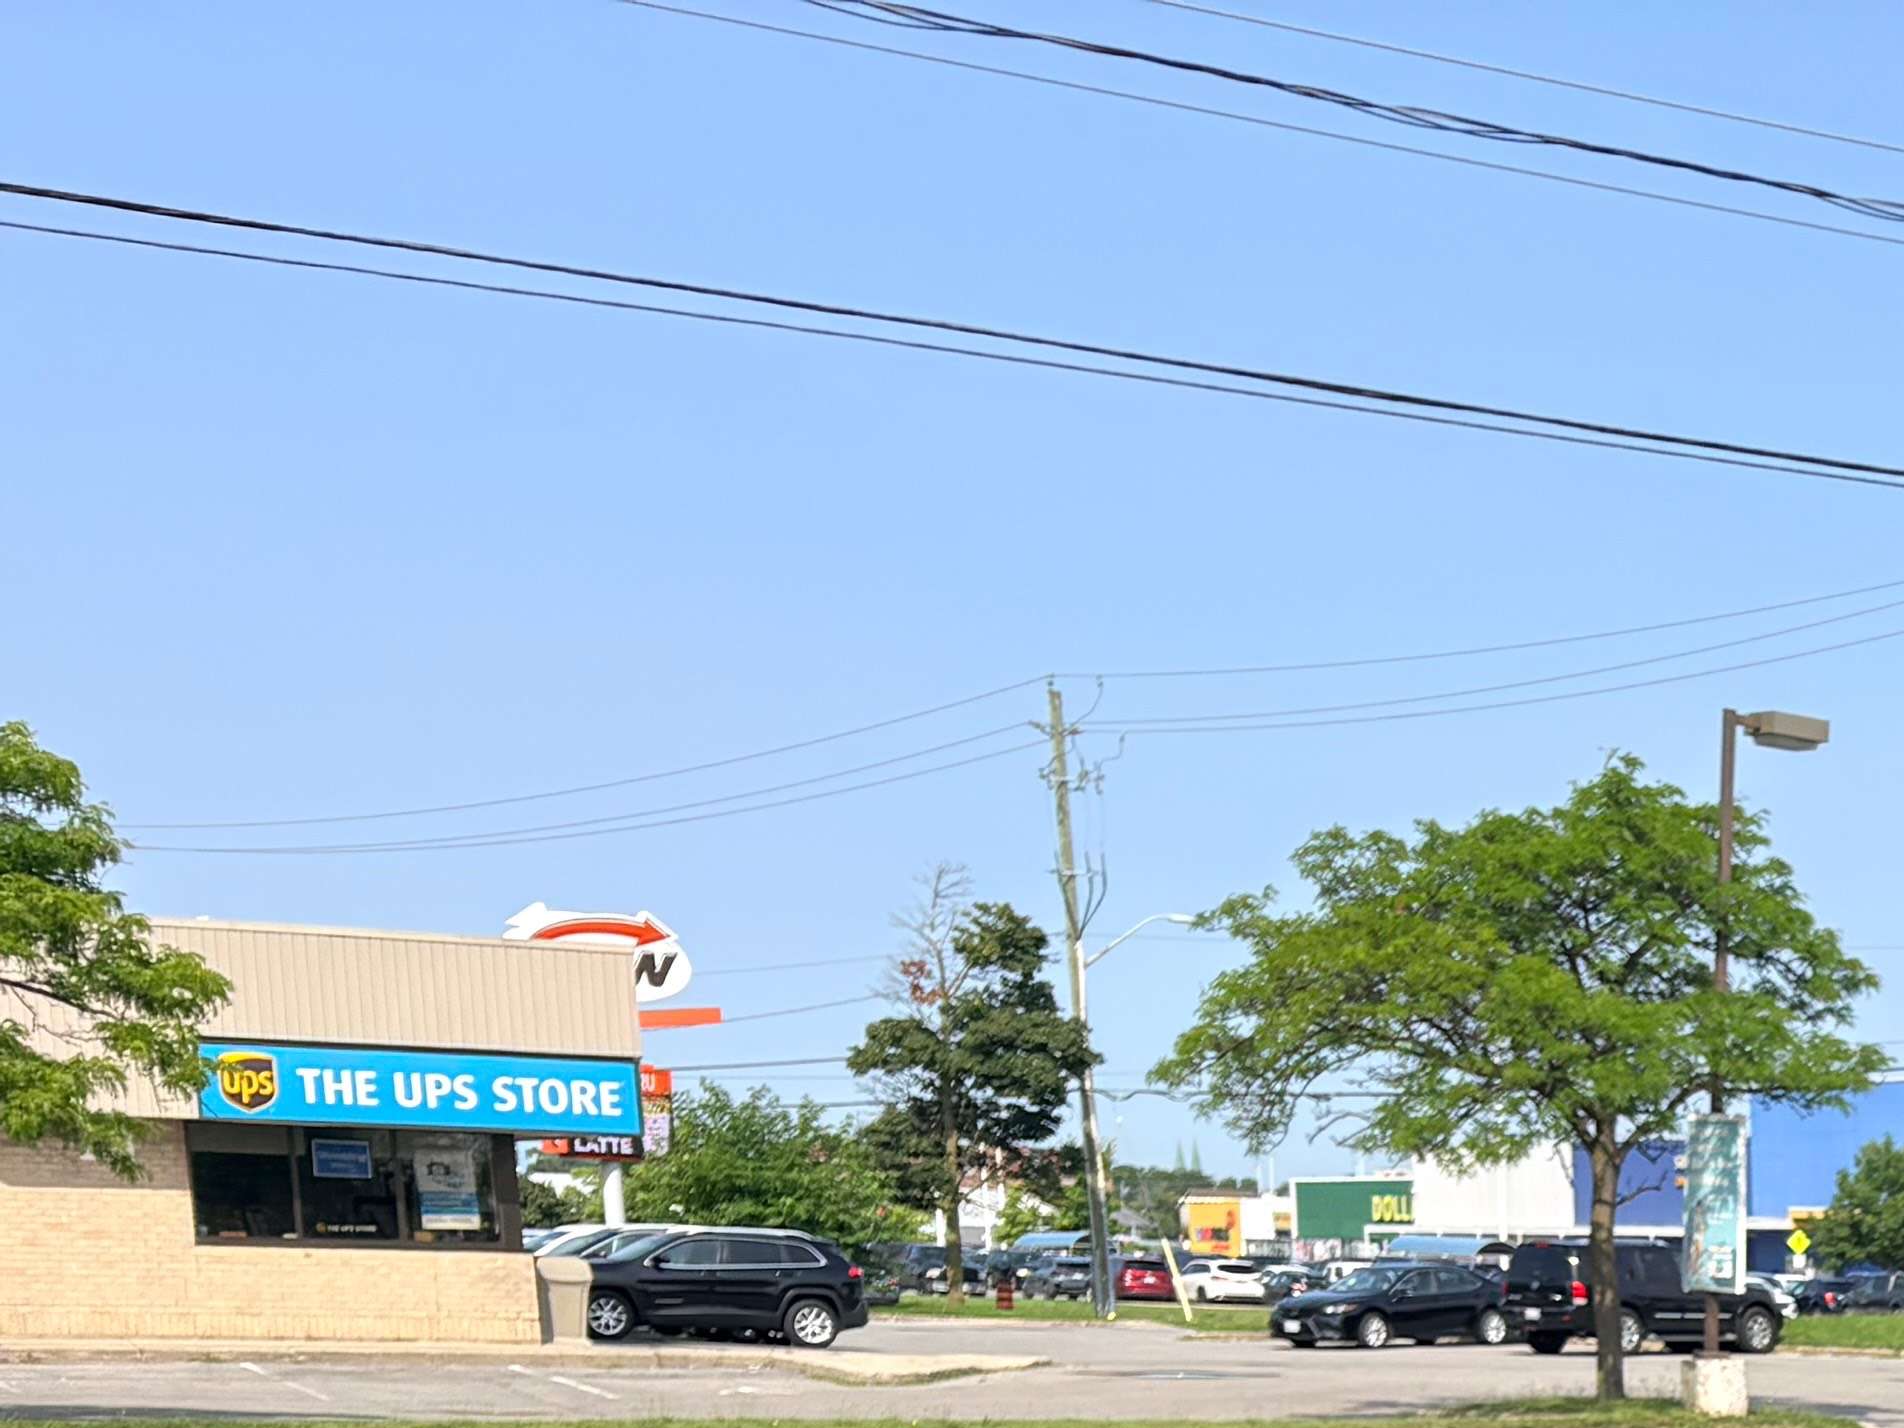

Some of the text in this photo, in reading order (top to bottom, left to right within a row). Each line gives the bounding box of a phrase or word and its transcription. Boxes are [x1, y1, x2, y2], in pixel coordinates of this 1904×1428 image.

[223, 1068, 274, 1103] ups
[296, 1067, 623, 1117] THE UPS STORE
[574, 1136, 634, 1155] LATTE
